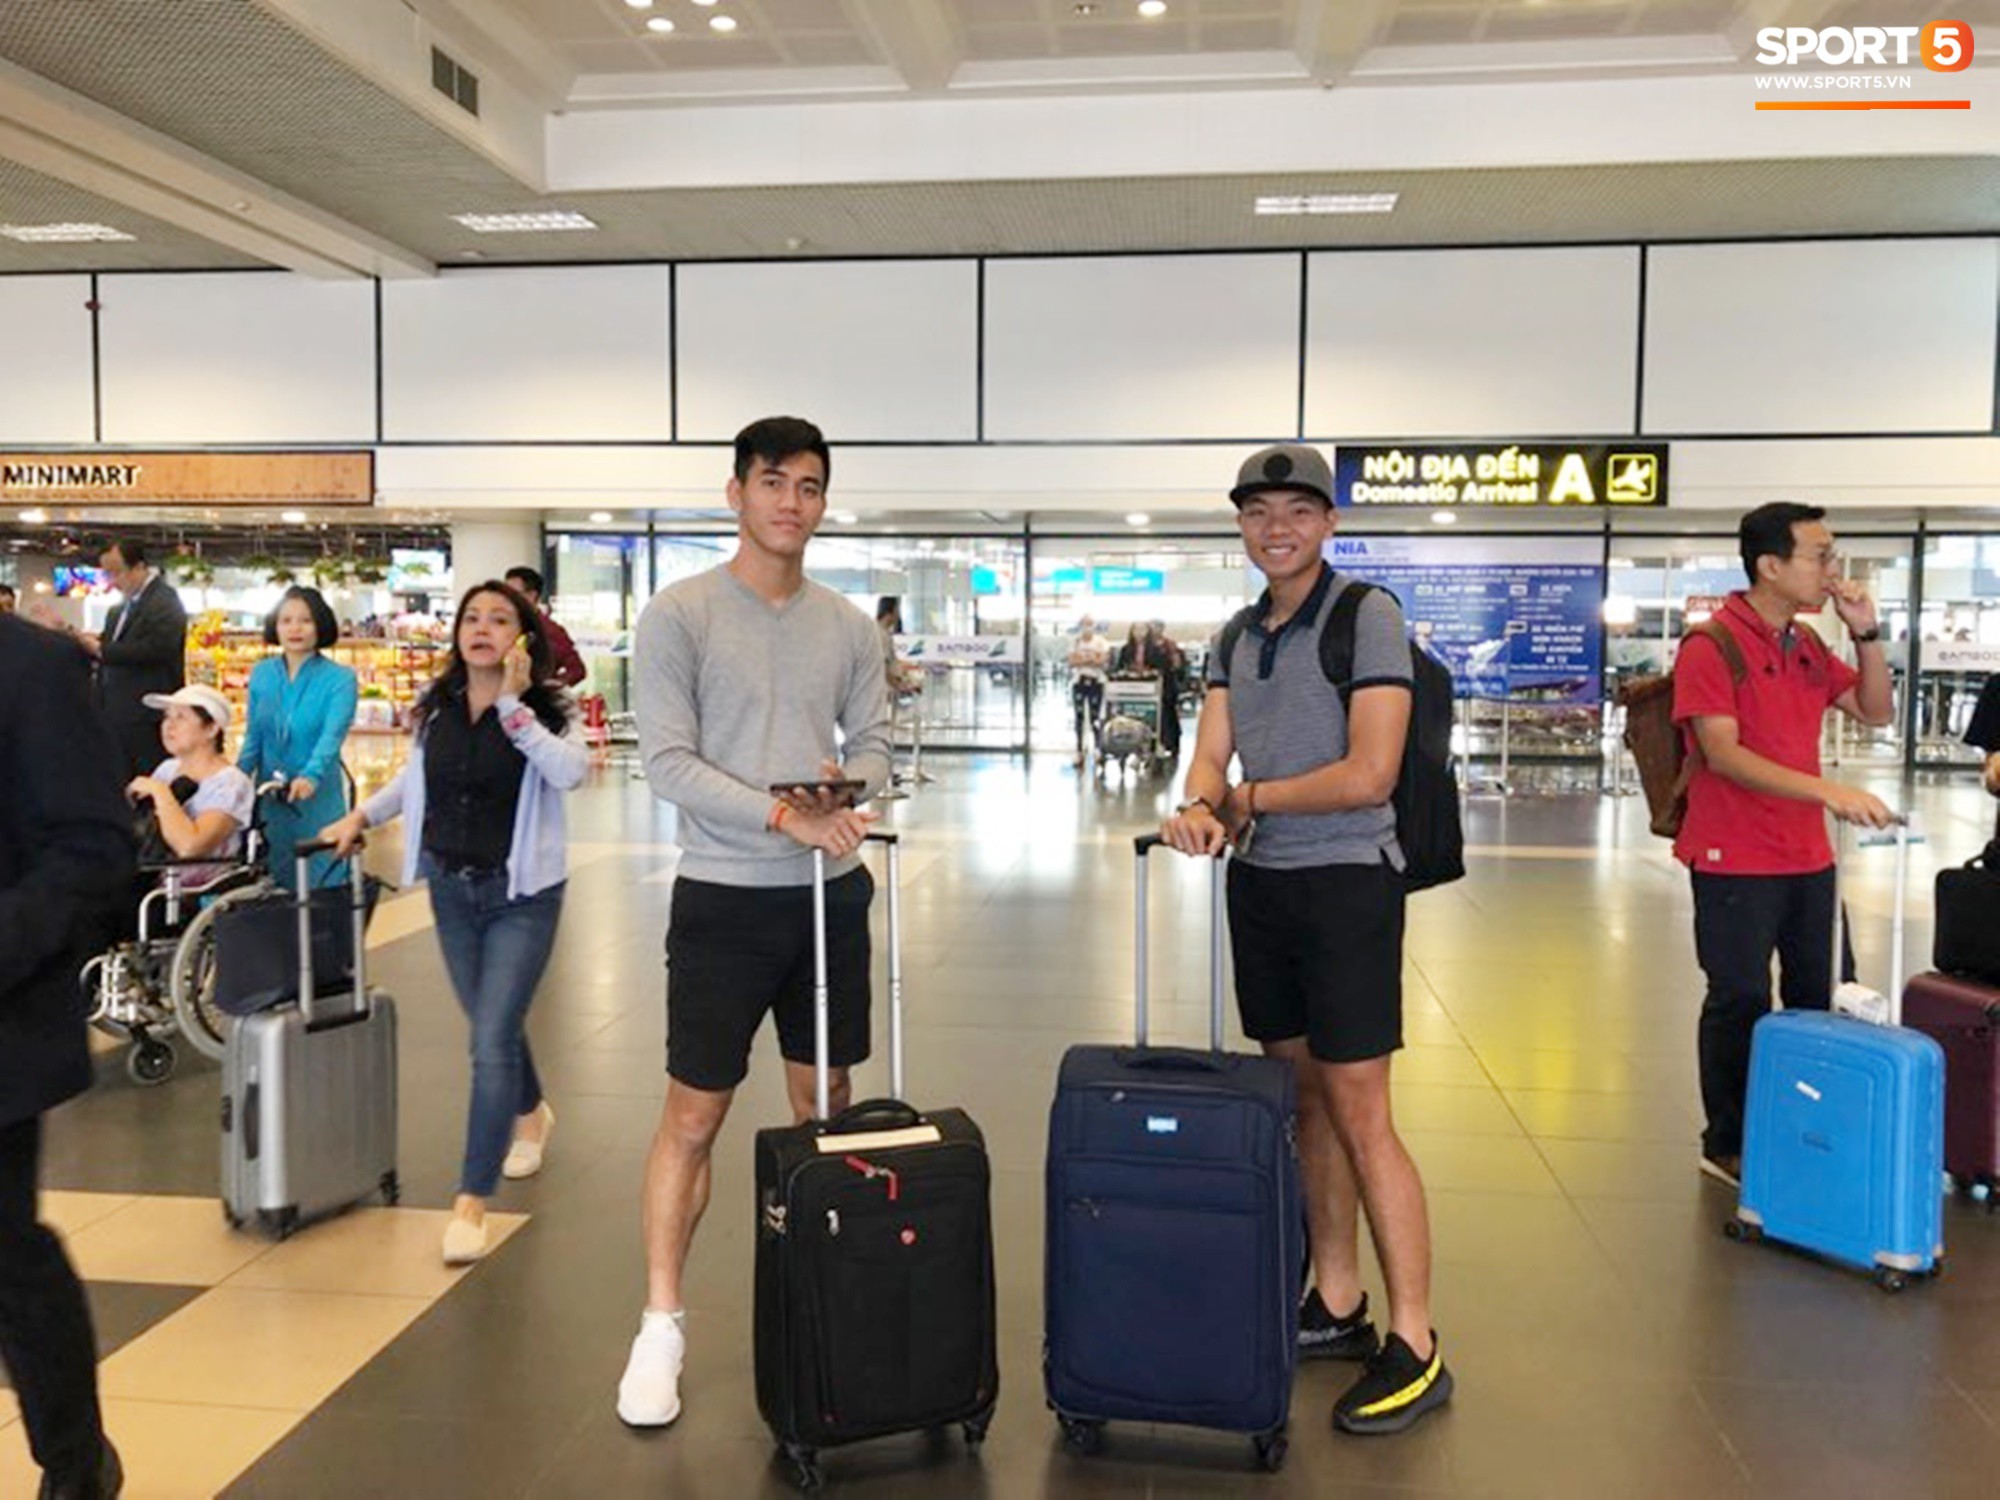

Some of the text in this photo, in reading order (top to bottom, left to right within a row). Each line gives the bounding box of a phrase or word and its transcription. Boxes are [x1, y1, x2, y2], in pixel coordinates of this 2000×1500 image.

[3, 463, 139, 487] MINIMART
[1363, 446, 1596, 504] NỘI ĐỊA ĐẾN A
[1350, 481, 1538, 504] Domestic Arrival
[1334, 541, 1368, 555] NIA
